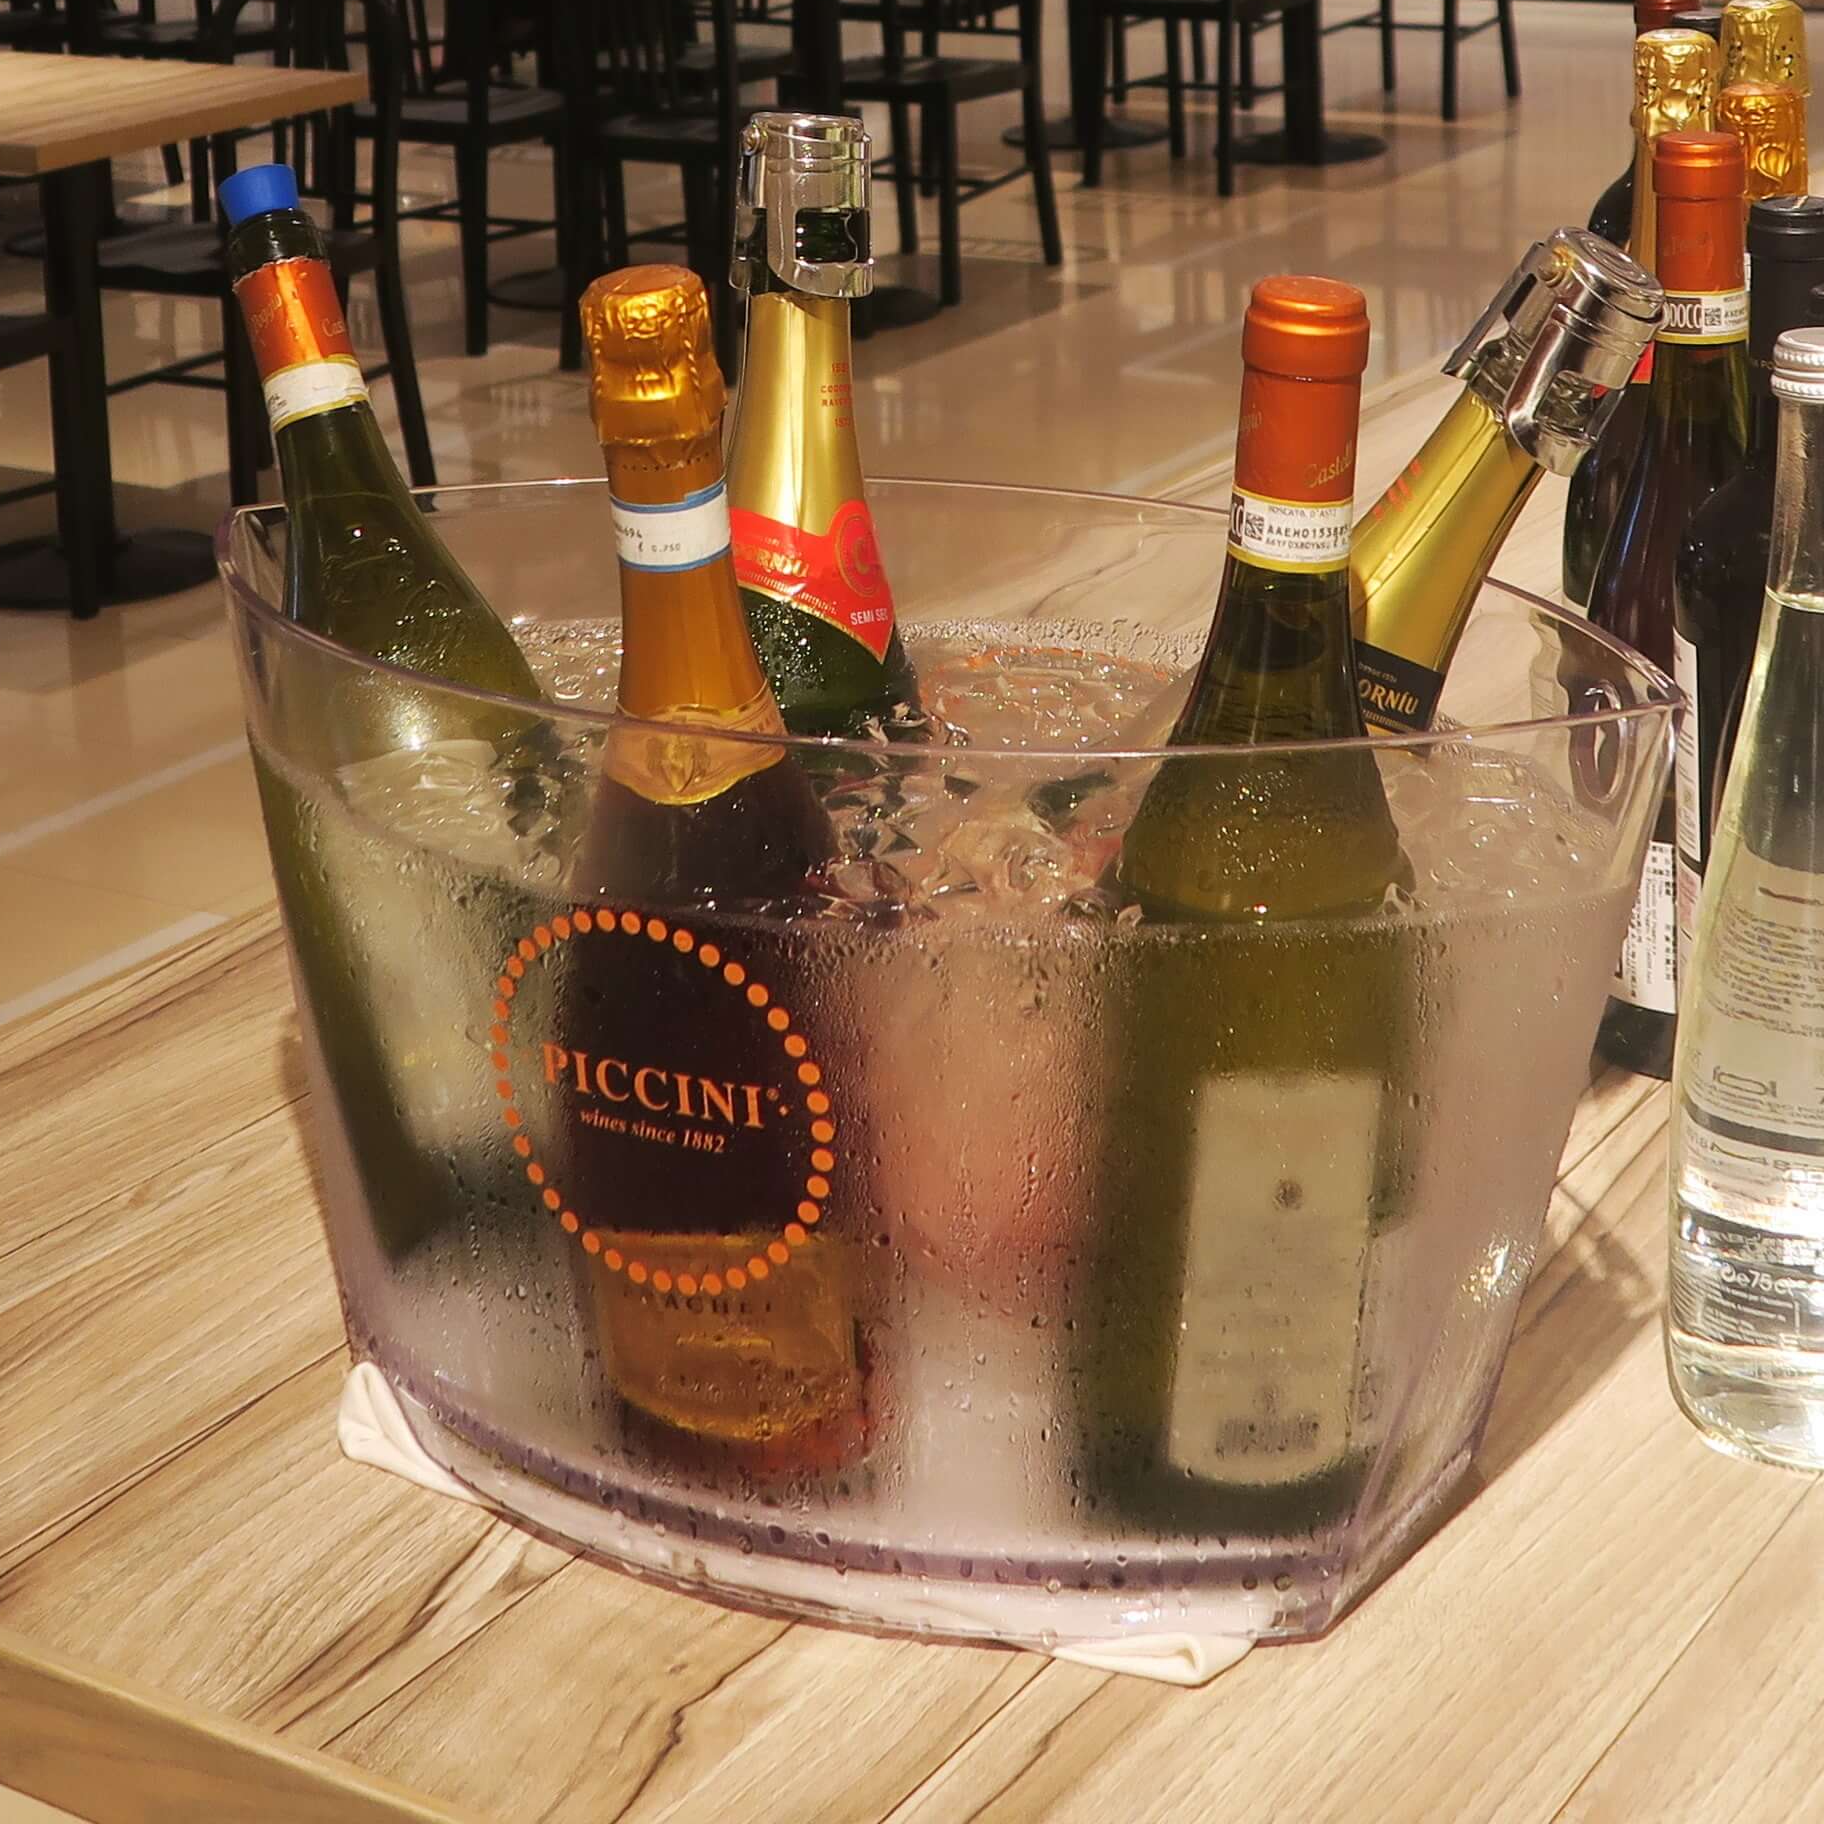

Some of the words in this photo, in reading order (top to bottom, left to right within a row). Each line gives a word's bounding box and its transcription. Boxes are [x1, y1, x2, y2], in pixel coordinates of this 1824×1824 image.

[580, 1108, 626, 1133] wines
[631, 1119, 675, 1144] since
[681, 1129, 725, 1154] 1882
